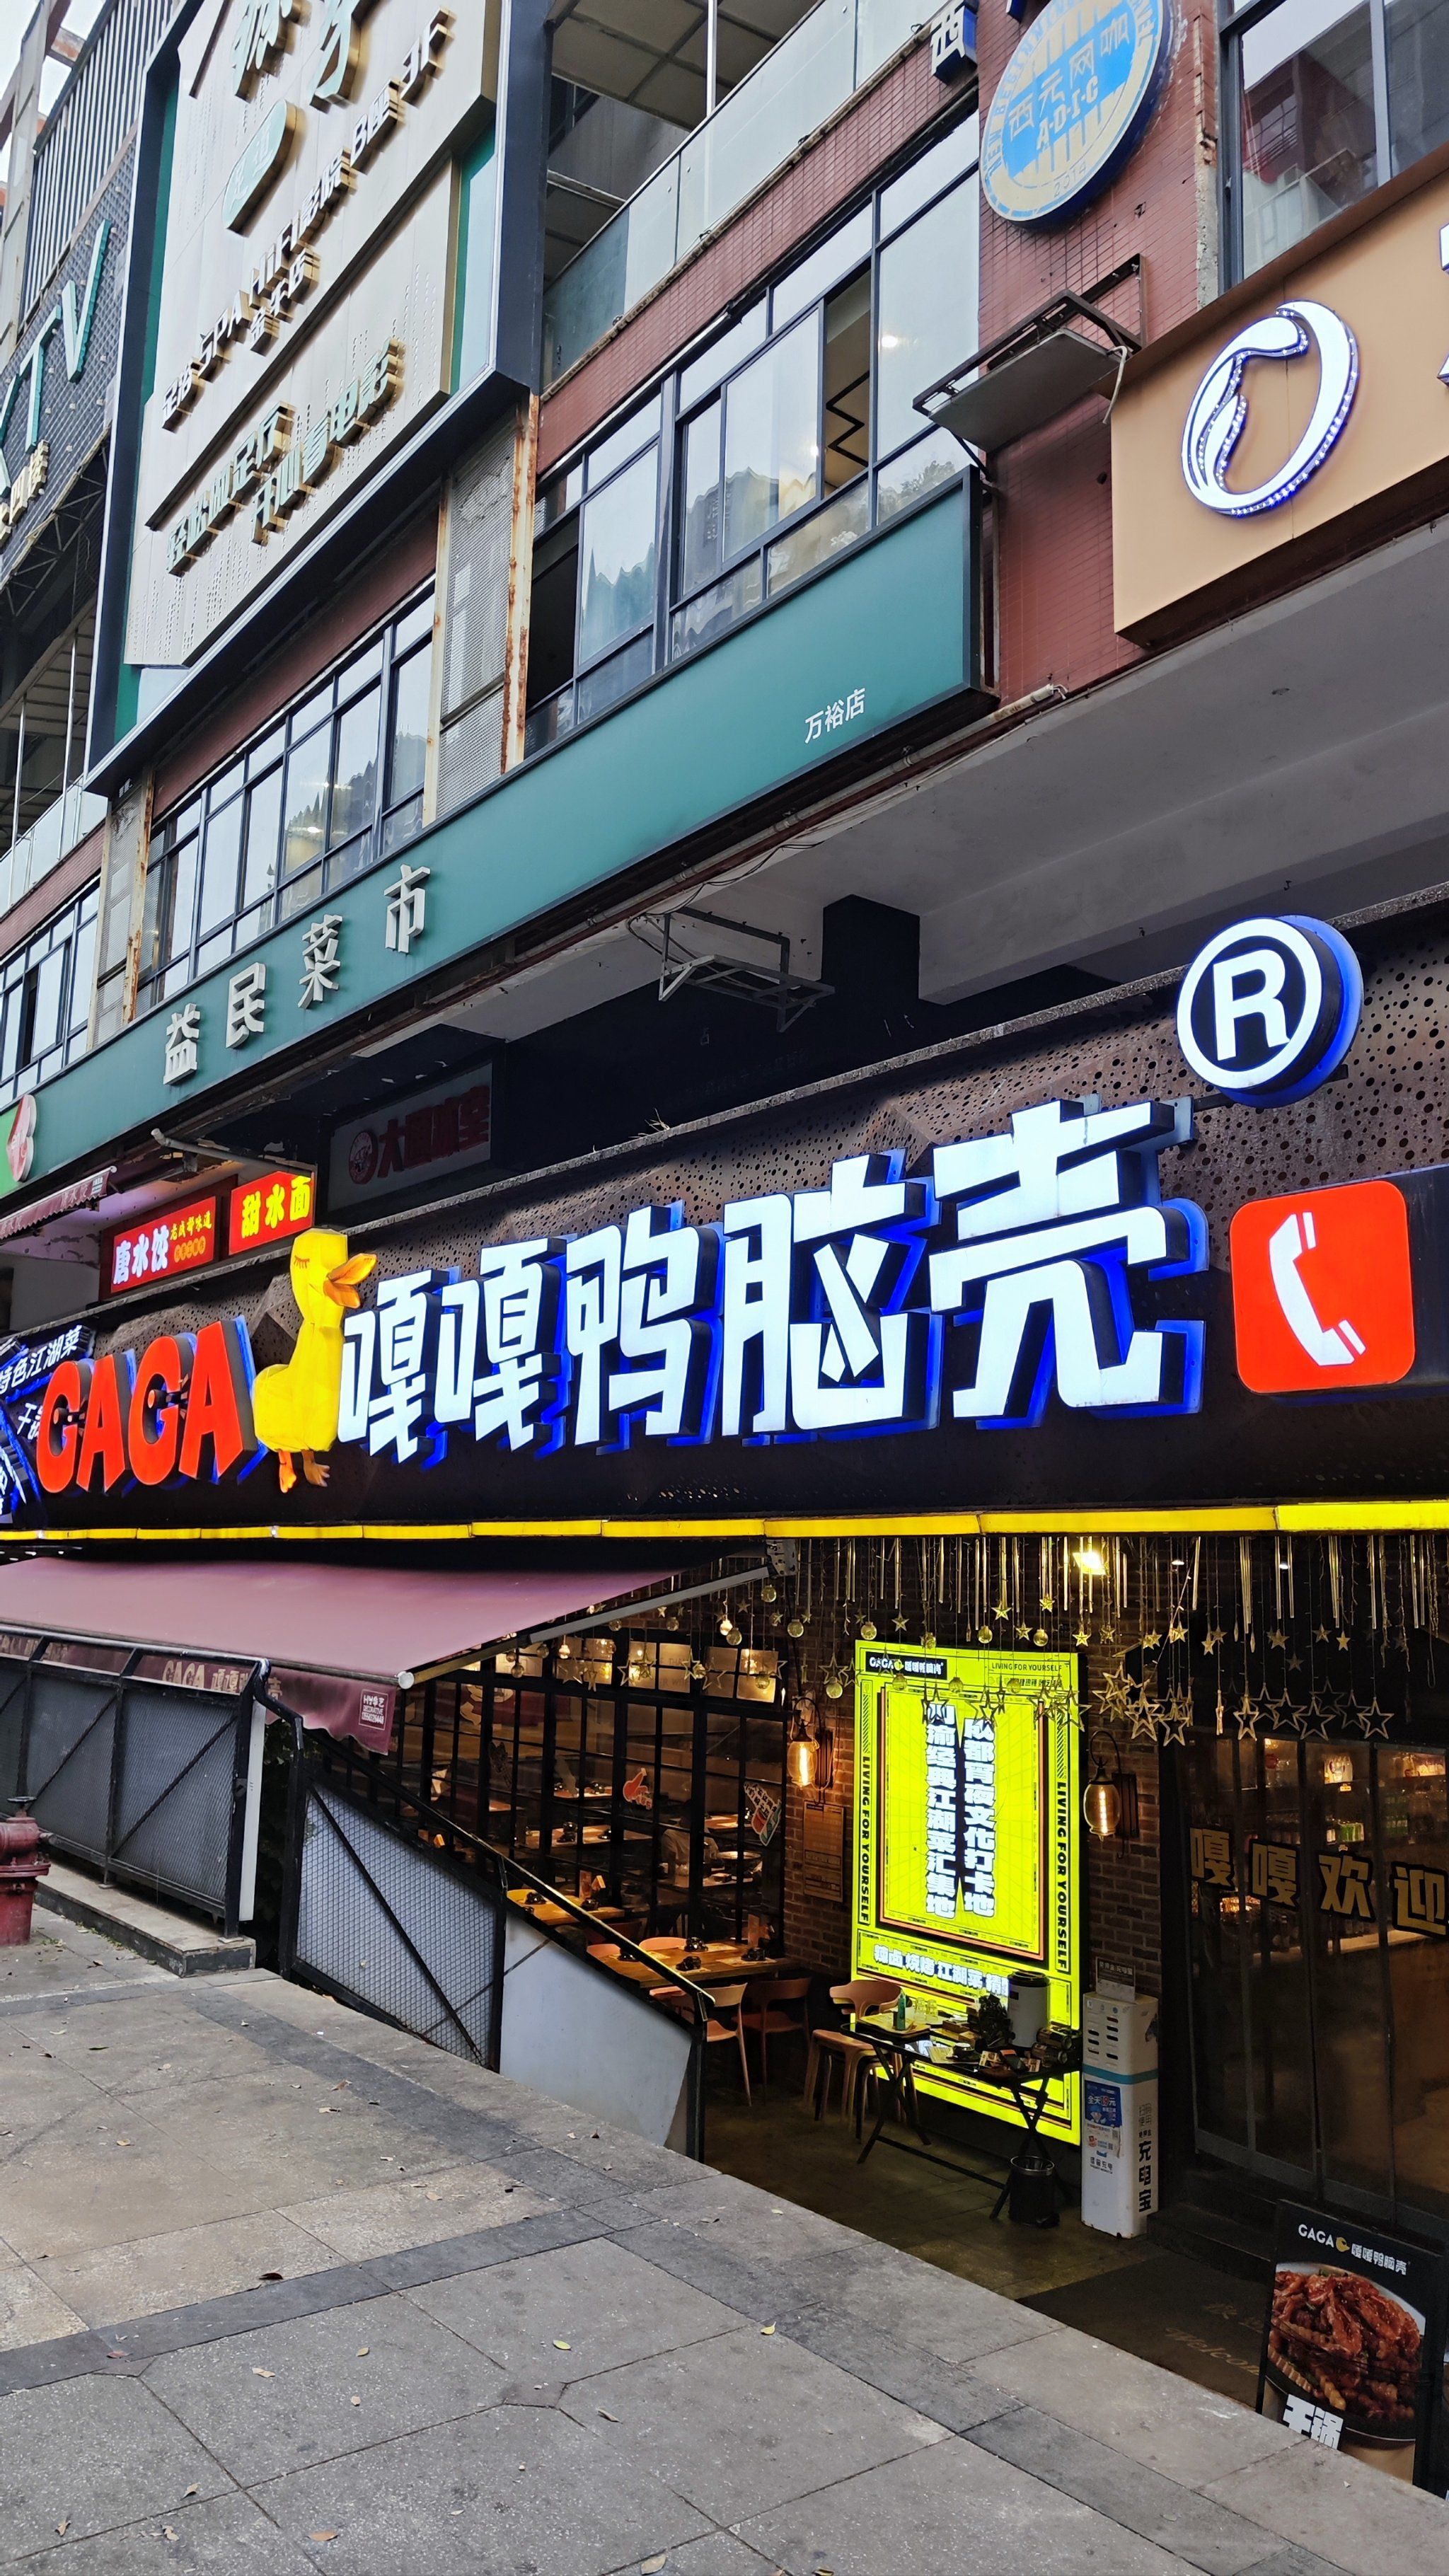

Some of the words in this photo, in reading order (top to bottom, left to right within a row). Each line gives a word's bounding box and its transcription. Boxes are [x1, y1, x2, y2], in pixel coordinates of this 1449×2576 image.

[1009, 13, 1130, 141] 西元网咖
[163, 363, 192, 423] 足浴
[200, 289, 243, 378] SPA
[252, 339, 393, 543] 开心看电影
[804, 688, 865, 744] 万裕店
[163, 864, 430, 1084] 益民菜市
[171, 1211, 212, 1241] 老成都味道
[241, 1175, 311, 1238] 甜水面
[113, 1225, 169, 1284] 唐水饺
[37, 1320, 243, 1493] GAGA
[338, 1100, 1174, 1462] 嘎嘎鸭脑壳
[0, 1324, 82, 1394] 特色江湖菜
[163, 1660, 204, 1690] GAGA
[862, 1810, 870, 1837] FOR
[1057, 1781, 1067, 1836] LIVING
[860, 1841, 870, 1922] YOURSELF
[1057, 1842, 1067, 1876] FOR
[1189, 1827, 1447, 1936] 嘎嘎欢迎
[1057, 1880, 1068, 1972] YOURSELF
[1138, 2139, 1152, 2213] 充电宝
[1298, 2224, 1334, 2248] GAGA
[1351, 2243, 1407, 2275] 嘎嘎鸭脑壳
[1165, 2326, 1259, 2376] Welcom
